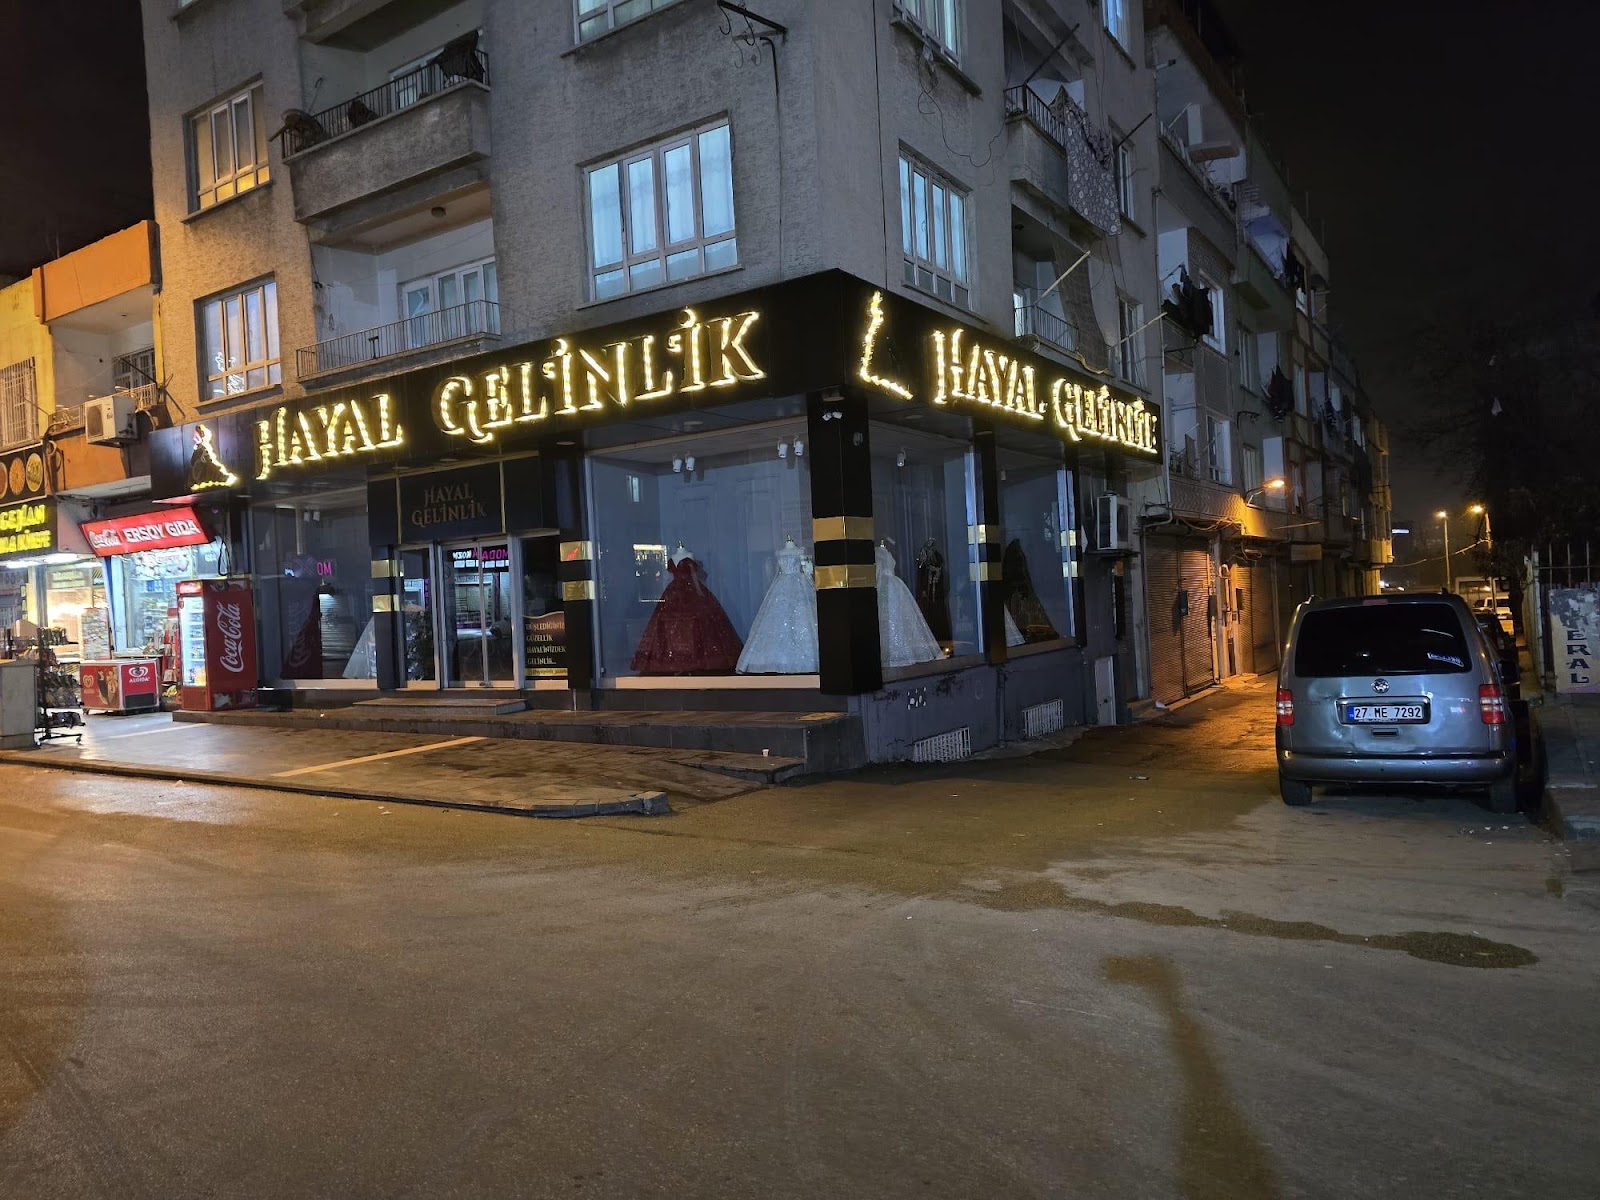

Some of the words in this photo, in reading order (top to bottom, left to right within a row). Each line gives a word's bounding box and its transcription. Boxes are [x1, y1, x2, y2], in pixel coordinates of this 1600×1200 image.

[256, 393, 405, 481] HAYAL
[437, 307, 768, 444] GELİNLİK
[423, 483, 475, 507] HAYAL
[411, 500, 487, 528] GELİNLİK
[123, 525, 166, 543] ERSOY
[165, 519, 201, 537] GIDA
[1355, 708, 1368, 719] 27
[1374, 708, 1388, 719] ME
[1394, 708, 1422, 719] 7292
